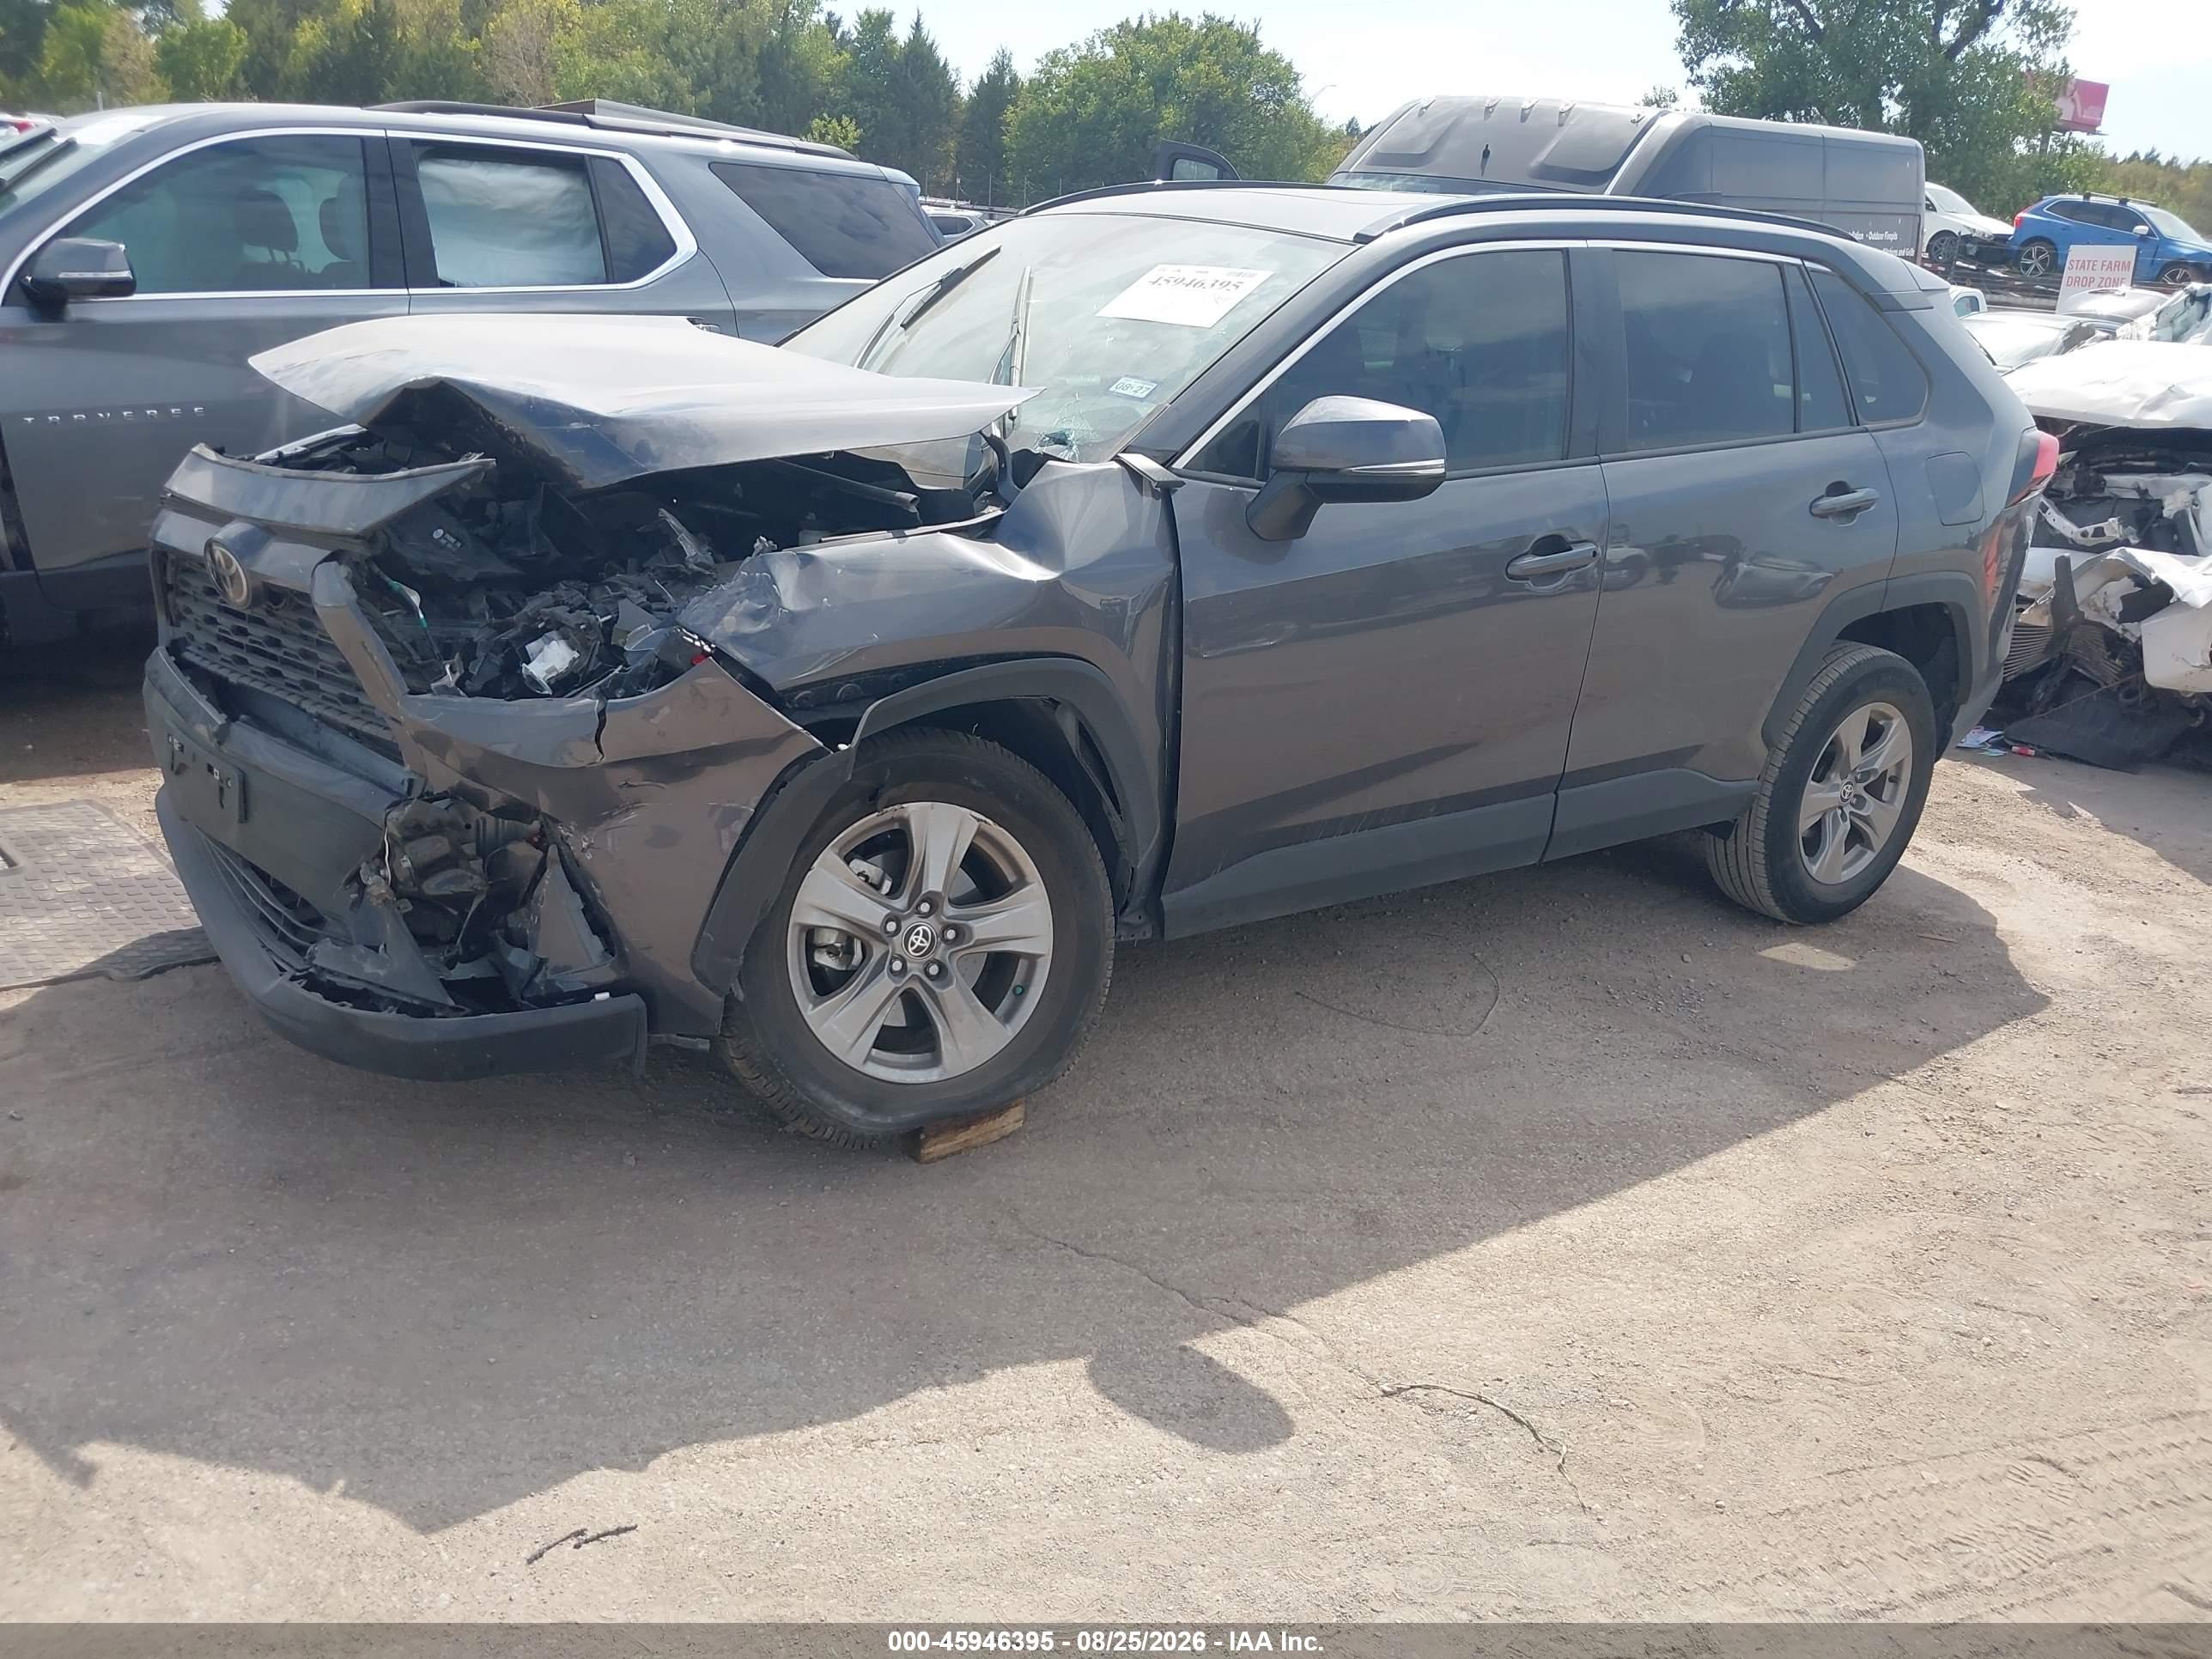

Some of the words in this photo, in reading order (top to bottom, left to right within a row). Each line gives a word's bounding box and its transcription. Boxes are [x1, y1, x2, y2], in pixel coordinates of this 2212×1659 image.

[1869, 230, 1884, 240] Outdoor
[2068, 260, 2098, 271] STATE
[2100, 260, 2131, 272] FARM
[1148, 276, 1244, 292] 45946395
[2066, 276, 2095, 288] DROP
[22, 406, 206, 426] TRAVERSE
